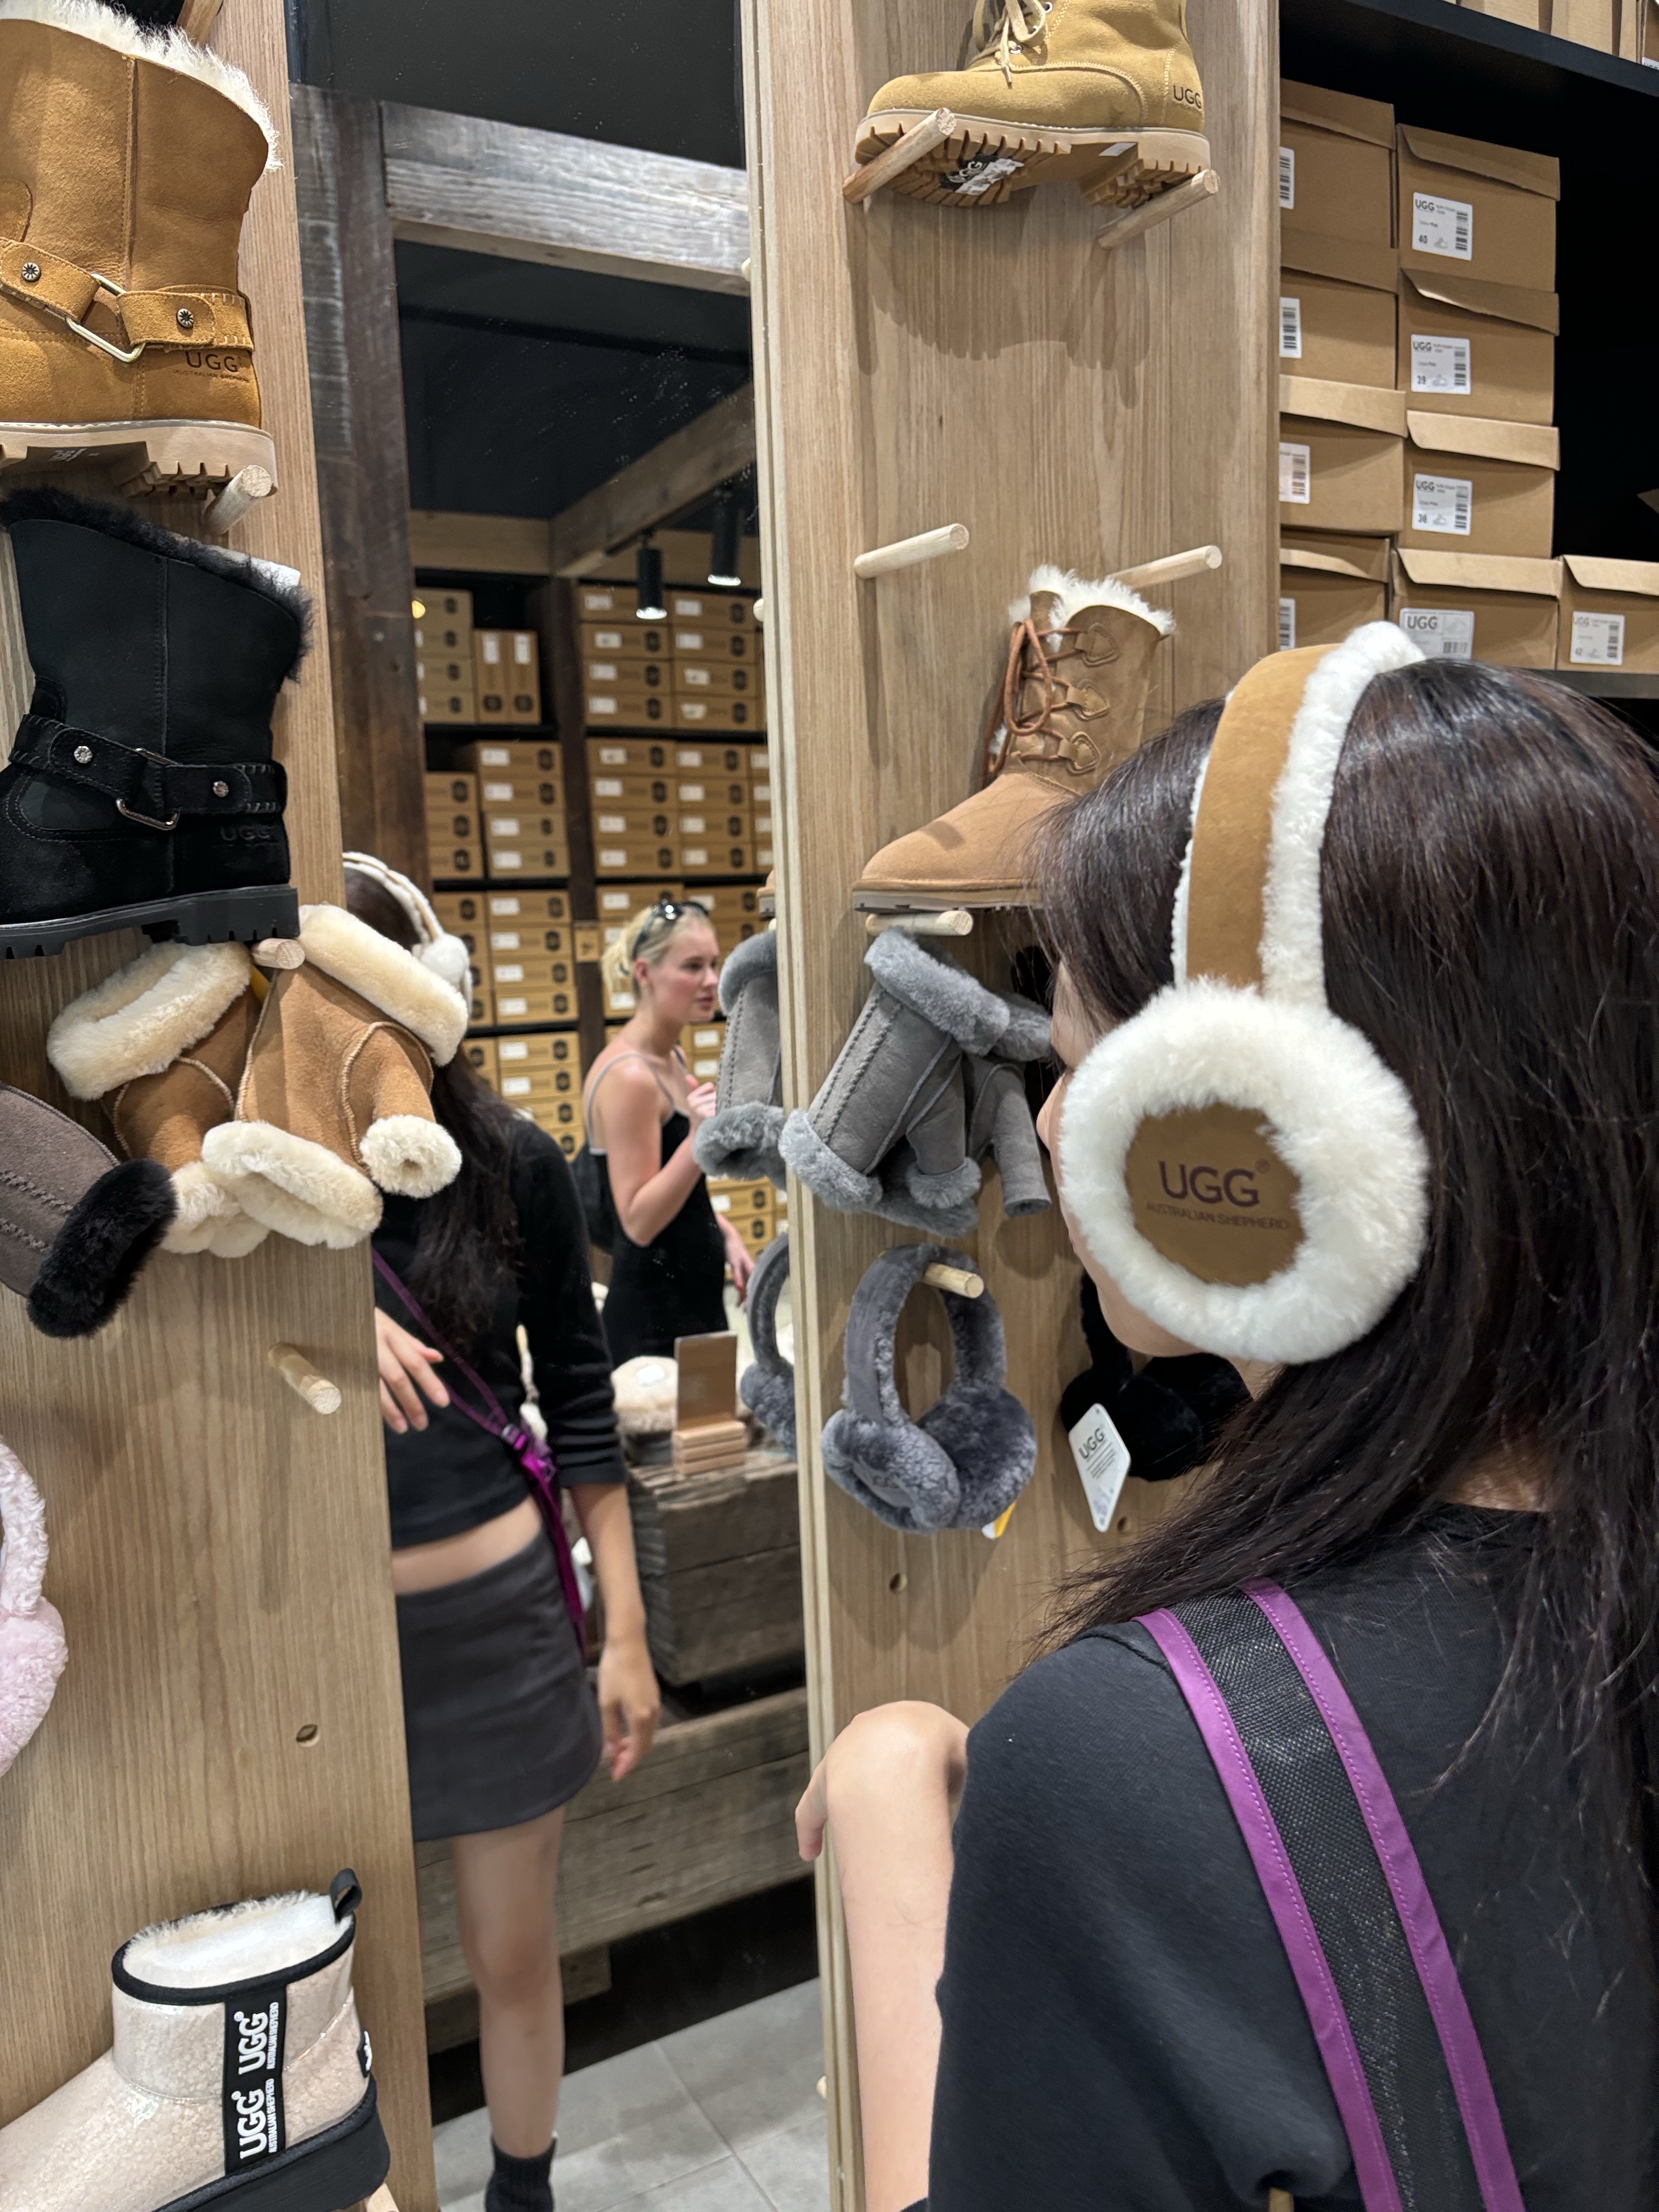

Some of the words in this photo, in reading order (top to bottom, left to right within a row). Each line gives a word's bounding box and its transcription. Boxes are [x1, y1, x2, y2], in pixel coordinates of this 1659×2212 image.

[1173, 85, 1202, 109] UGG
[1415, 199, 1435, 211] UGG
[1413, 341, 1432, 351] UGG
[184, 351, 239, 373] UGG
[1415, 479, 1435, 492] UGG
[1407, 616, 1438, 630] UGG
[221, 825, 271, 841] UGG
[1159, 1160, 1260, 1207] UGG
[1078, 1427, 1105, 1459] UGG
[238, 2012, 268, 2075] UGG
[236, 2089, 267, 2159] UGG
